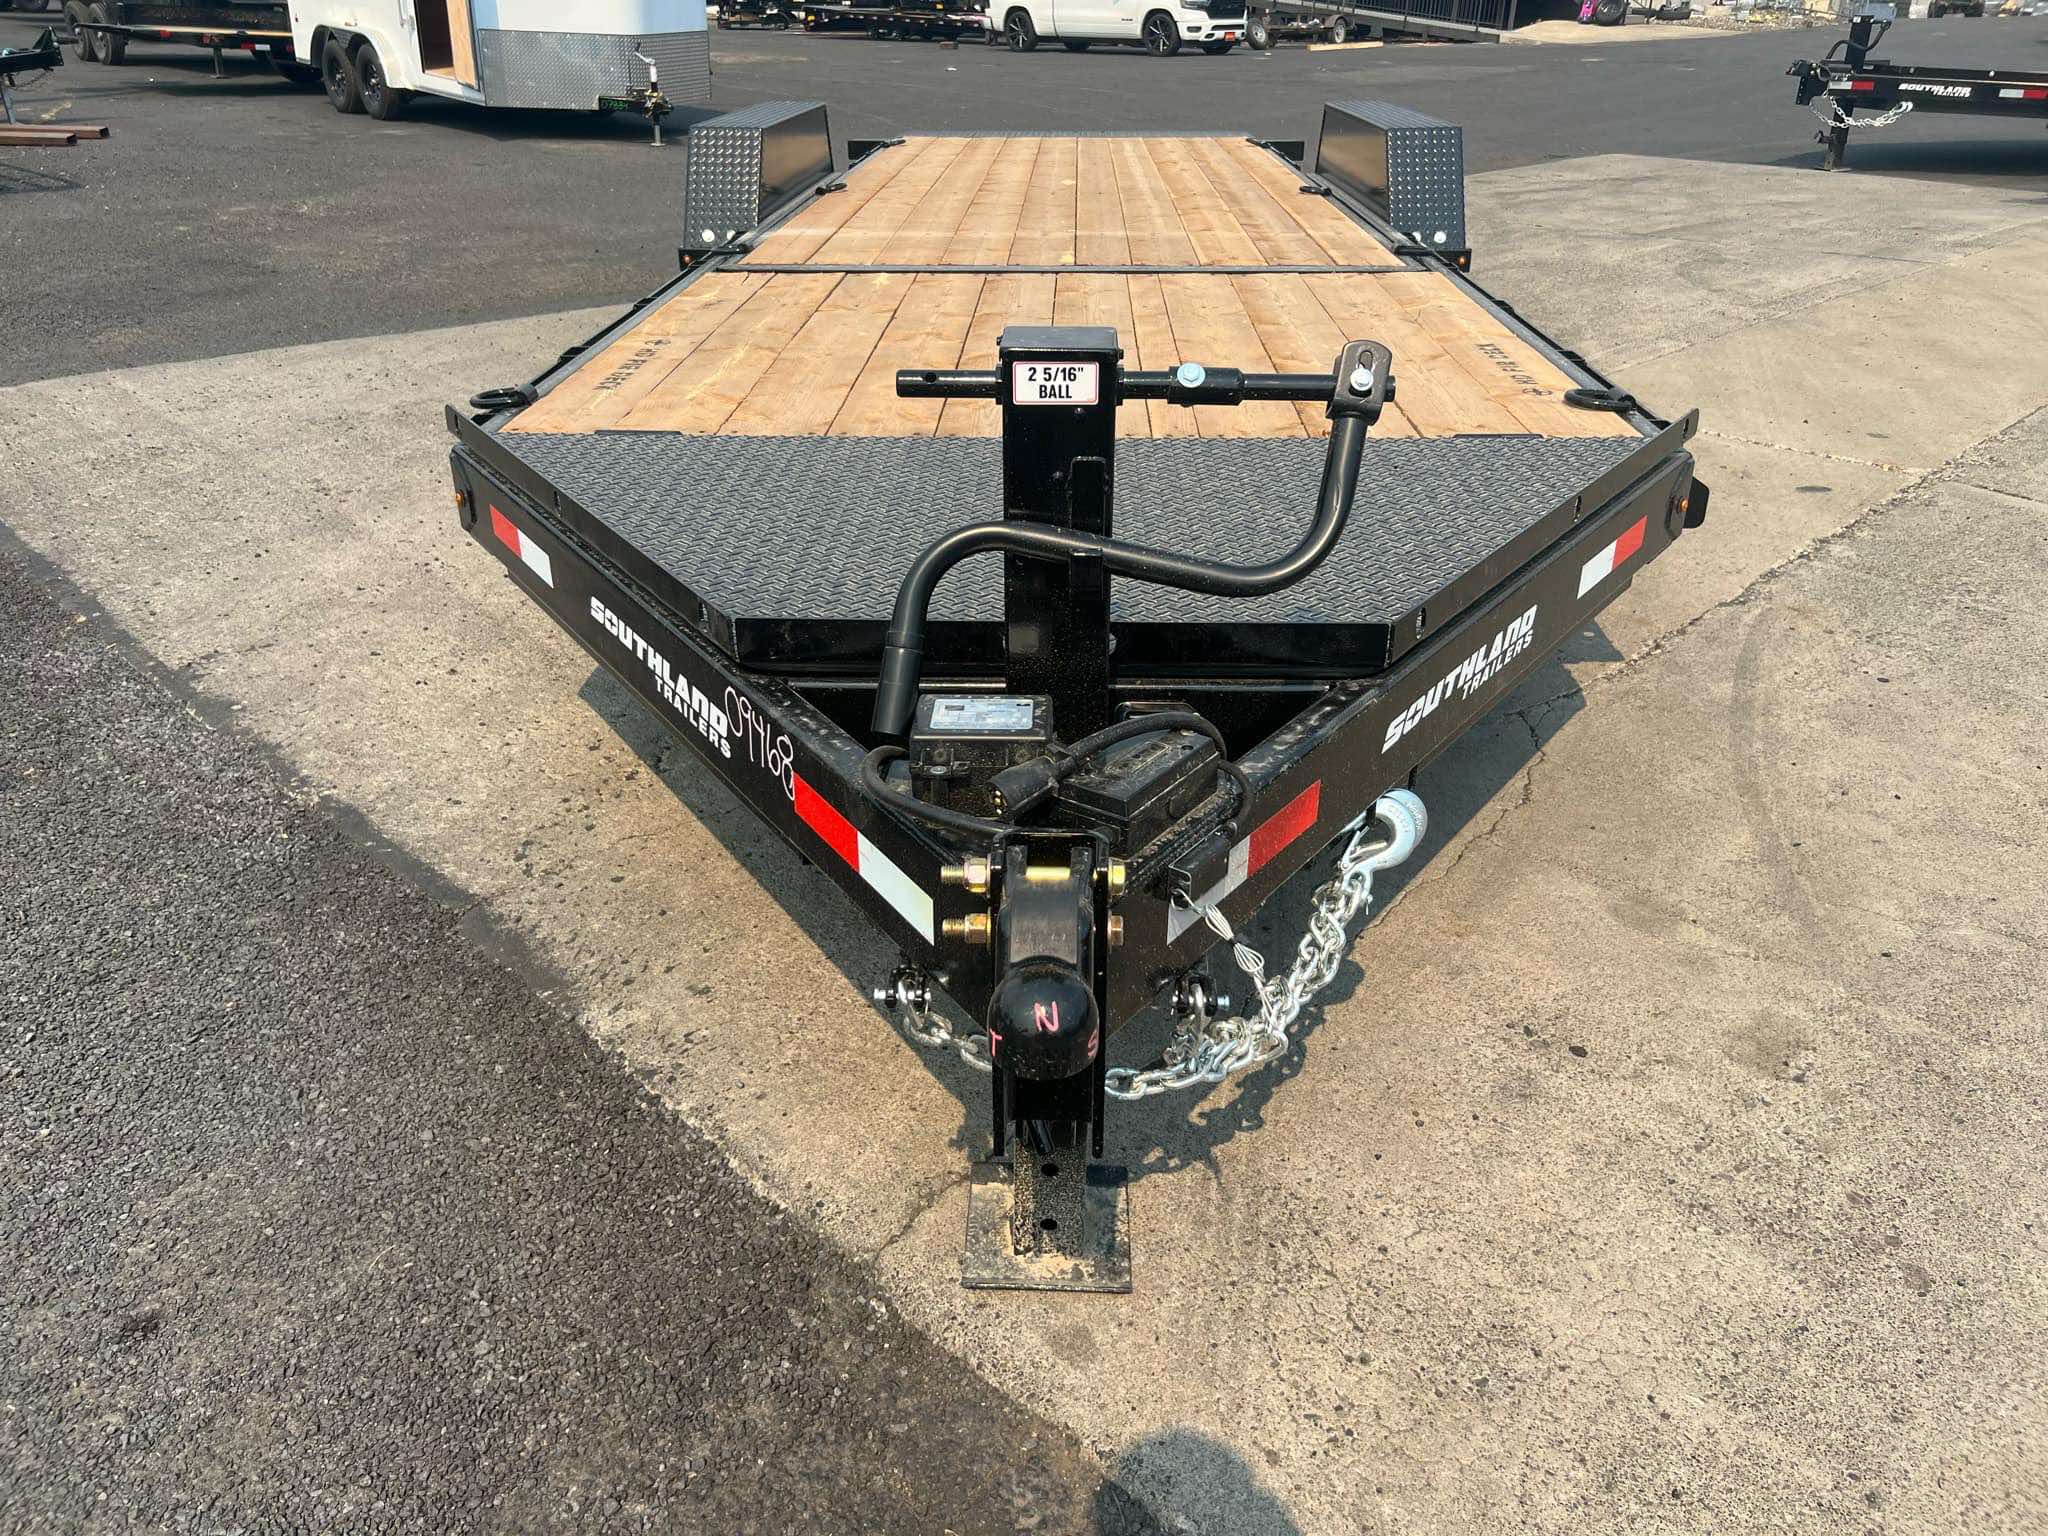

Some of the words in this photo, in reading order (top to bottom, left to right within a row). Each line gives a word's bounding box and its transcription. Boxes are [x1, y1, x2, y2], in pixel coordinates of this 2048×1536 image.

[1028, 366, 1037, 382] 2
[1043, 366, 1084, 382] 5/16"
[1039, 384, 1073, 399] BALL
[590, 596, 728, 738] SOUTHLAND
[1381, 604, 1538, 755] SOUTHLAND
[1462, 629, 1535, 701] TRAILERS
[654, 674, 732, 759] TRAILERS
[725, 685, 796, 801] 09468
[1033, 999, 1060, 1032] N
